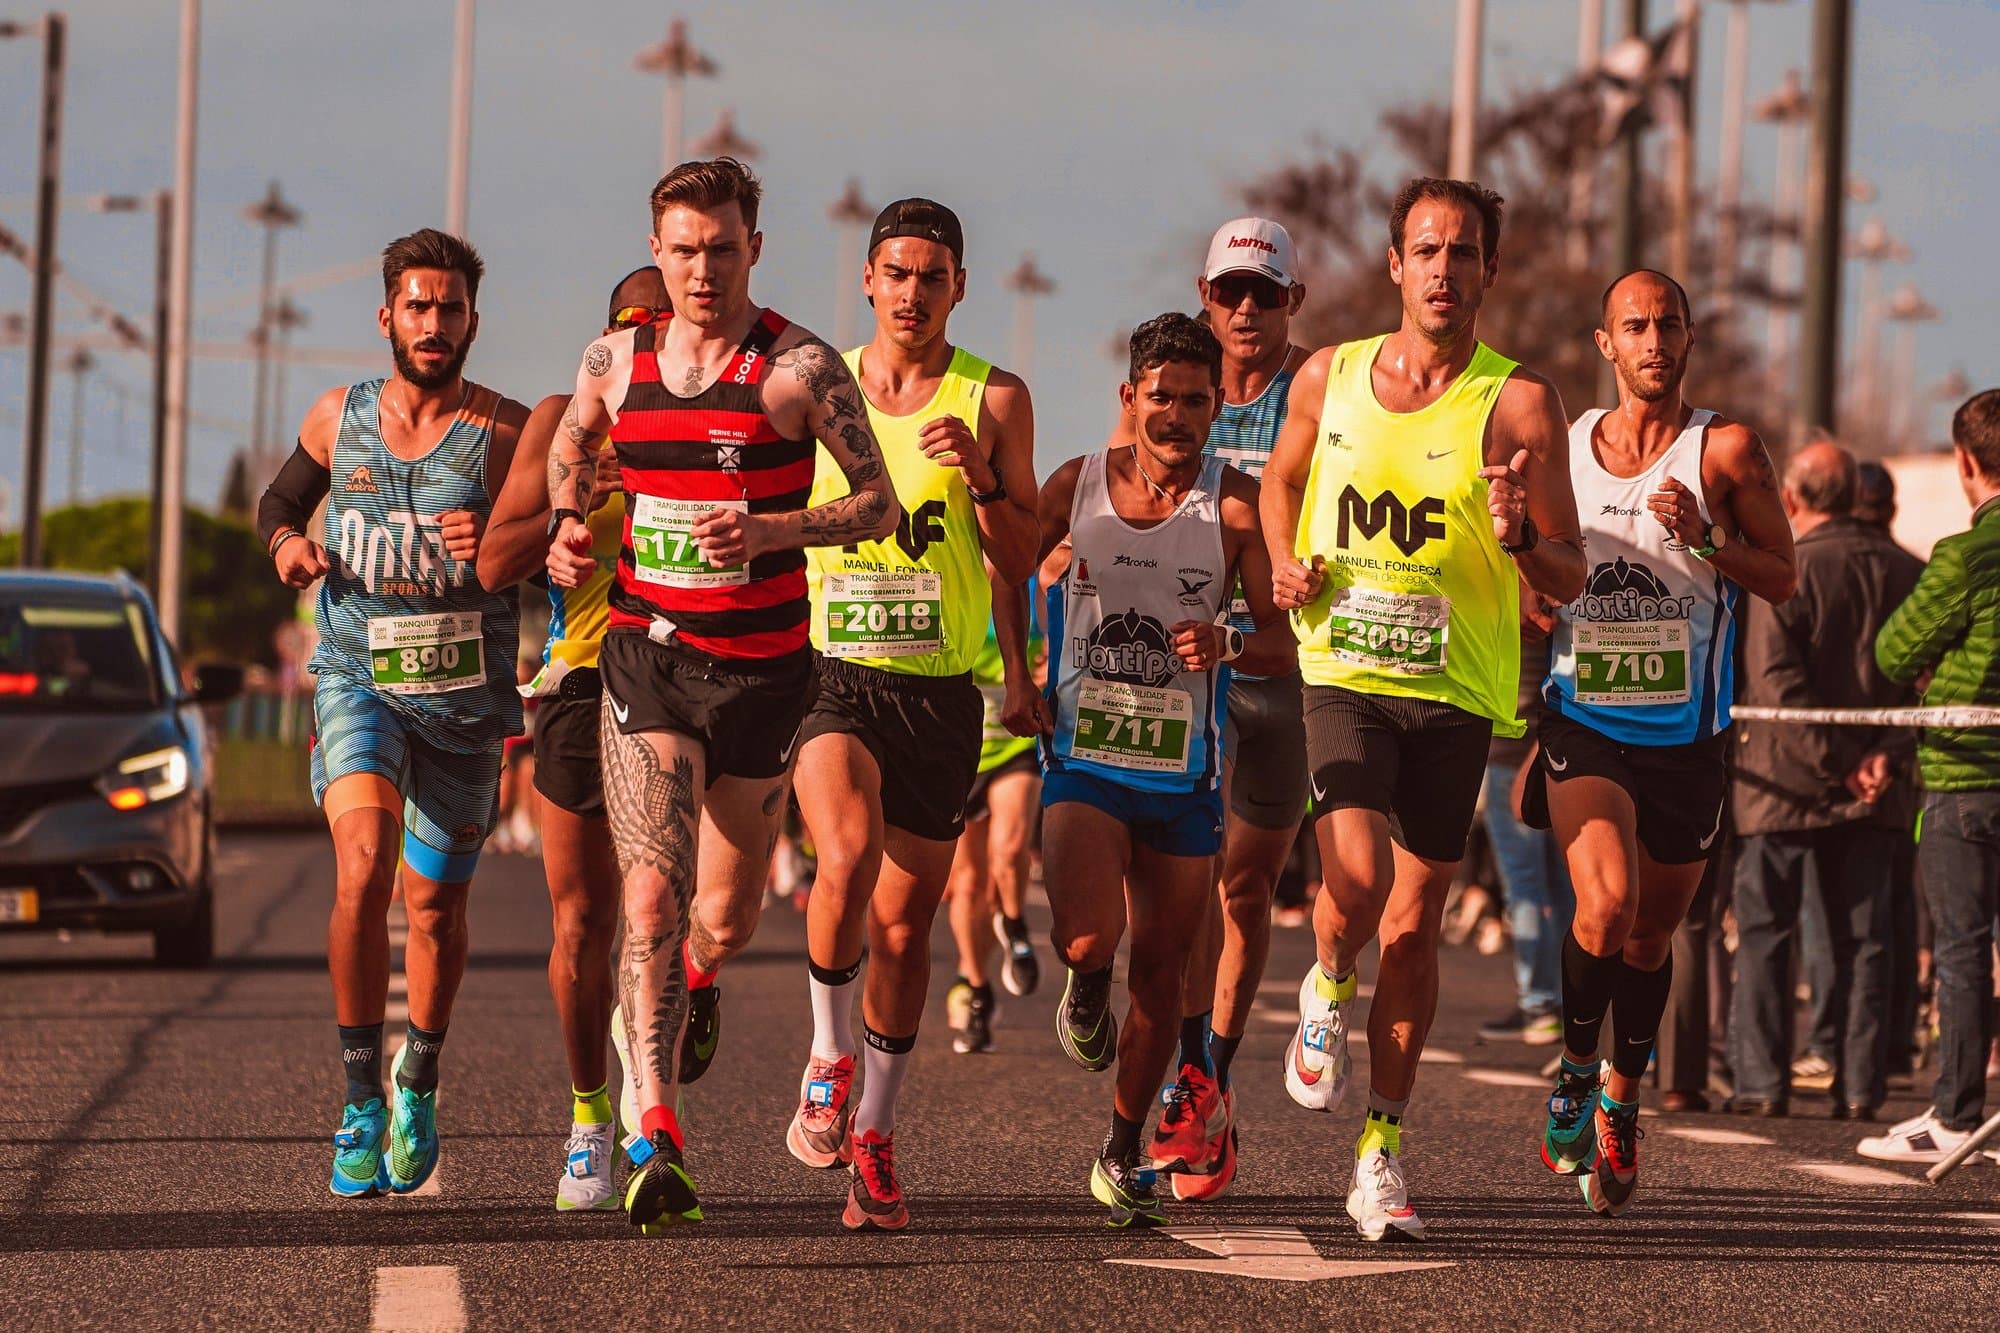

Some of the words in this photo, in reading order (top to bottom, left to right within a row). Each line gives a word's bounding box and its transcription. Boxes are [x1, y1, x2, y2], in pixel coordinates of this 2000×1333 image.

[709, 429, 731, 437] HERNE
[1328, 432, 1342, 447] MF
[711, 438, 746, 446] HARRIERS
[654, 501, 717, 512] TRANQUILIDADE
[652, 516, 695, 525] DESCOBRIM
[1336, 484, 1446, 557] MF
[1336, 554, 1382, 570] MANUEL
[1385, 561, 1442, 577] FONSECA
[850, 574, 916, 583] TRANQUILIDADE
[1382, 570, 1397, 582] de
[1358, 593, 1422, 607] TRANQUILIDADE
[846, 602, 931, 632] 2018
[1356, 608, 1420, 621] DESCOBRIMENTOS
[393, 617, 456, 629] TRANQUILIDADE
[1597, 625, 1660, 634] TRANQUILIDADE
[393, 631, 456, 642] DESCOBRIMENTOS
[1347, 620, 1432, 655] 2009
[400, 644, 460, 674] 890
[1073, 637, 1188, 681] Hortipo
[1602, 653, 1664, 682] 710
[1105, 685, 1167, 700] TRANQUILIDADE
[1102, 700, 1164, 713] DESCOBRIMENTOS
[1104, 714, 1163, 747] 711
[1099, 744, 1121, 753] VICTOR
